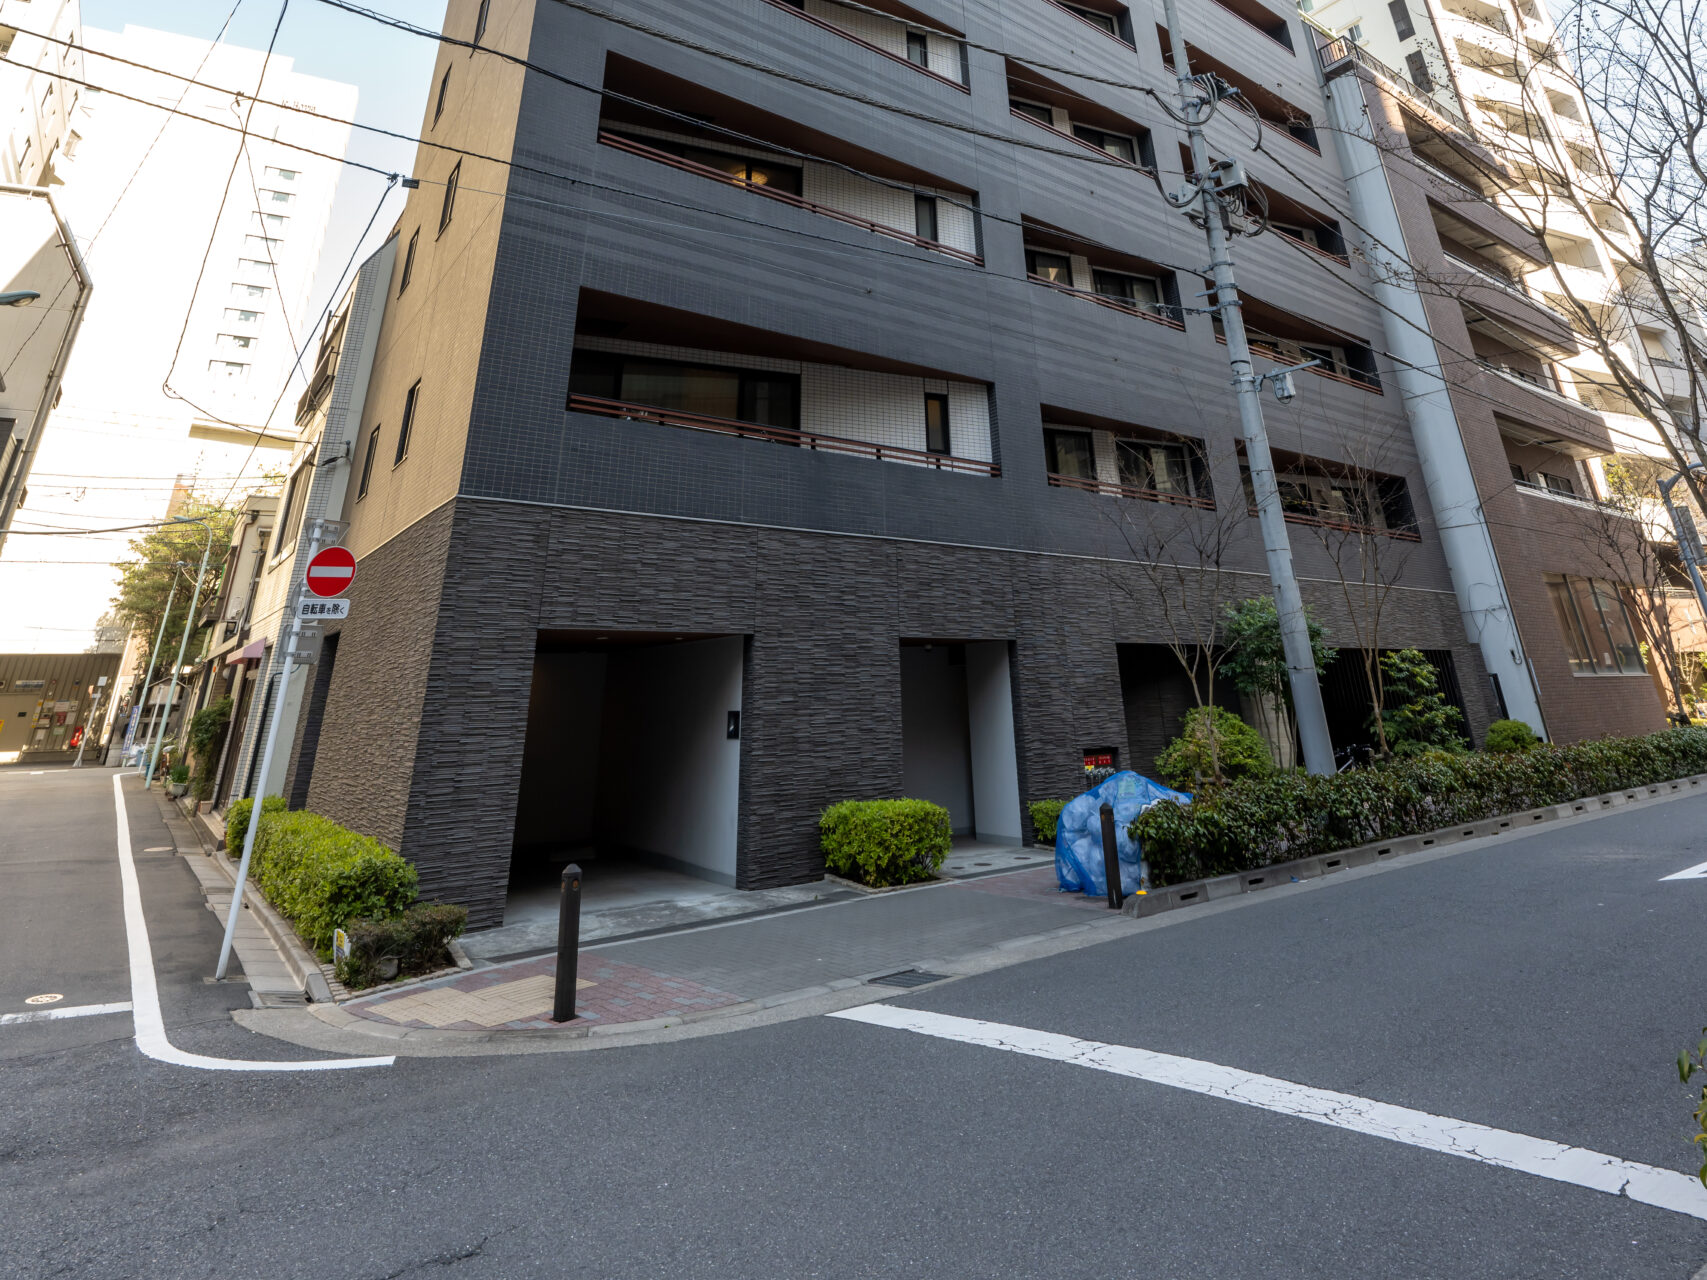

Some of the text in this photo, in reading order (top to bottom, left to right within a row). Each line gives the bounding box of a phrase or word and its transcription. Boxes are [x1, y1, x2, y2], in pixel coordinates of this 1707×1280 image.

[302, 603, 345, 615] 自転車を除く
